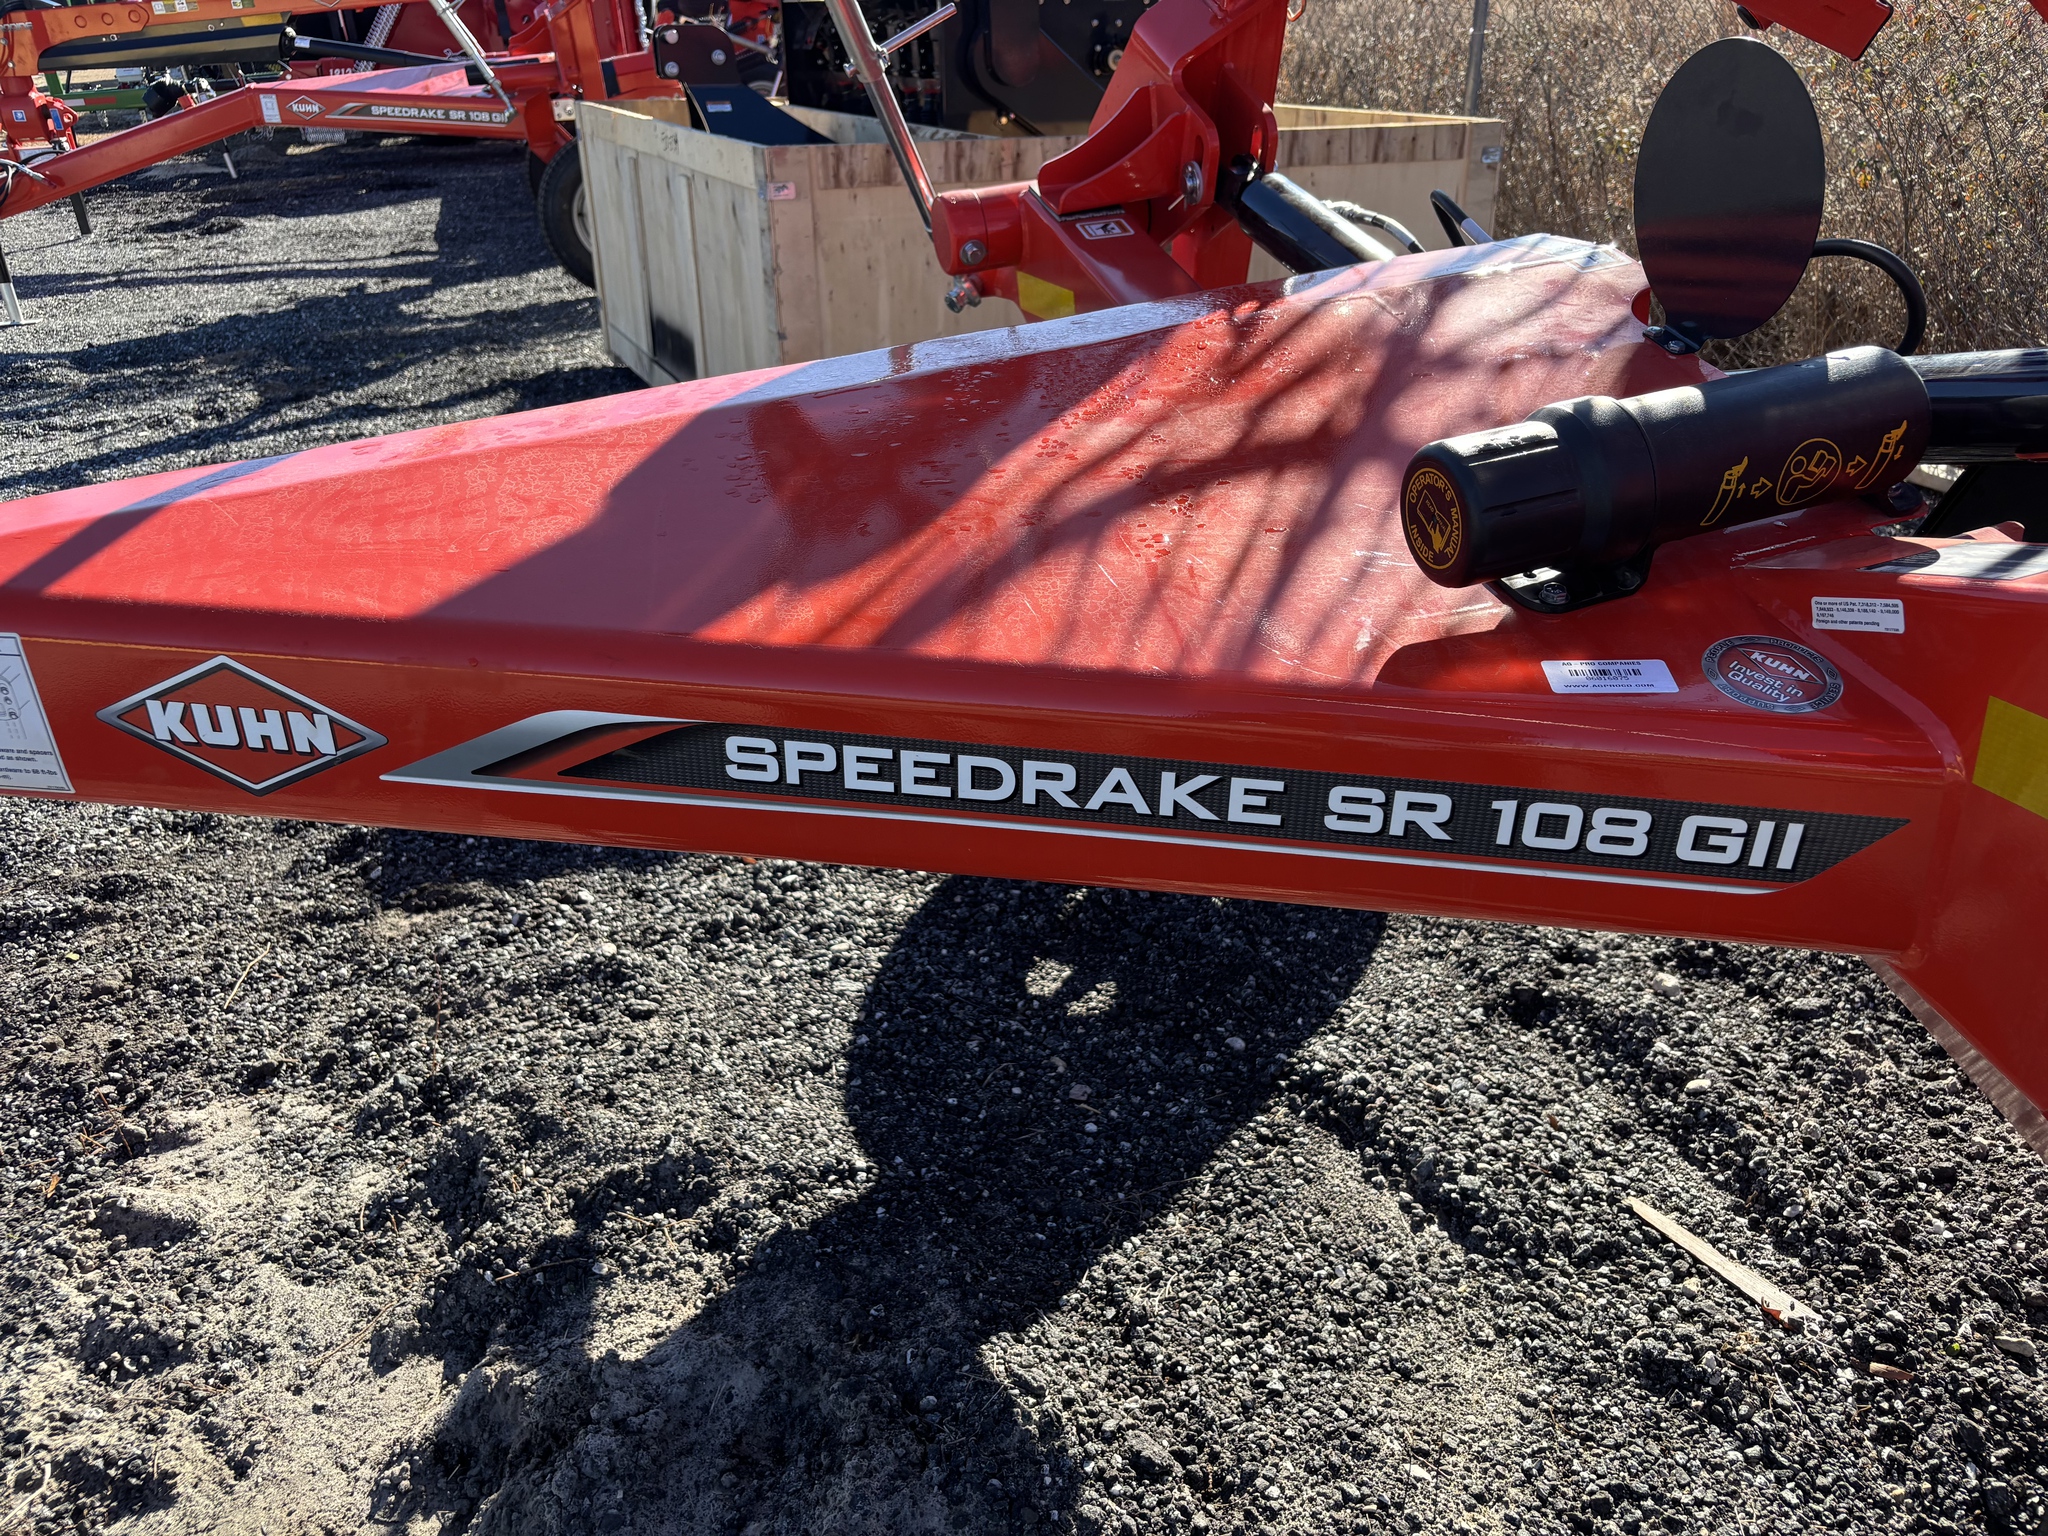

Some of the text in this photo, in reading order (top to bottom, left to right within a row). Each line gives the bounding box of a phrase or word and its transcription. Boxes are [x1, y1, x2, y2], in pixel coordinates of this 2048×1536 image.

[292, 103, 319, 113] KUHN
[371, 105, 446, 119] SPEEDRAKE
[449, 111, 466, 120] SR
[469, 112, 490, 121] 108
[1409, 473, 1459, 559] OPERATOR'S MANUAL
[1411, 524, 1435, 563] INSIDE
[1706, 638, 1840, 709] PEOPLE PRODUCTS SERVICE
[1729, 661, 1804, 697] Invest in
[1749, 651, 1811, 681] KUHN
[1718, 683, 1775, 711] SUPPORT
[1727, 670, 1791, 703] Quality
[145, 699, 338, 755] KUHN
[724, 736, 1805, 870] SPEEDRAKE SR 108 GII
